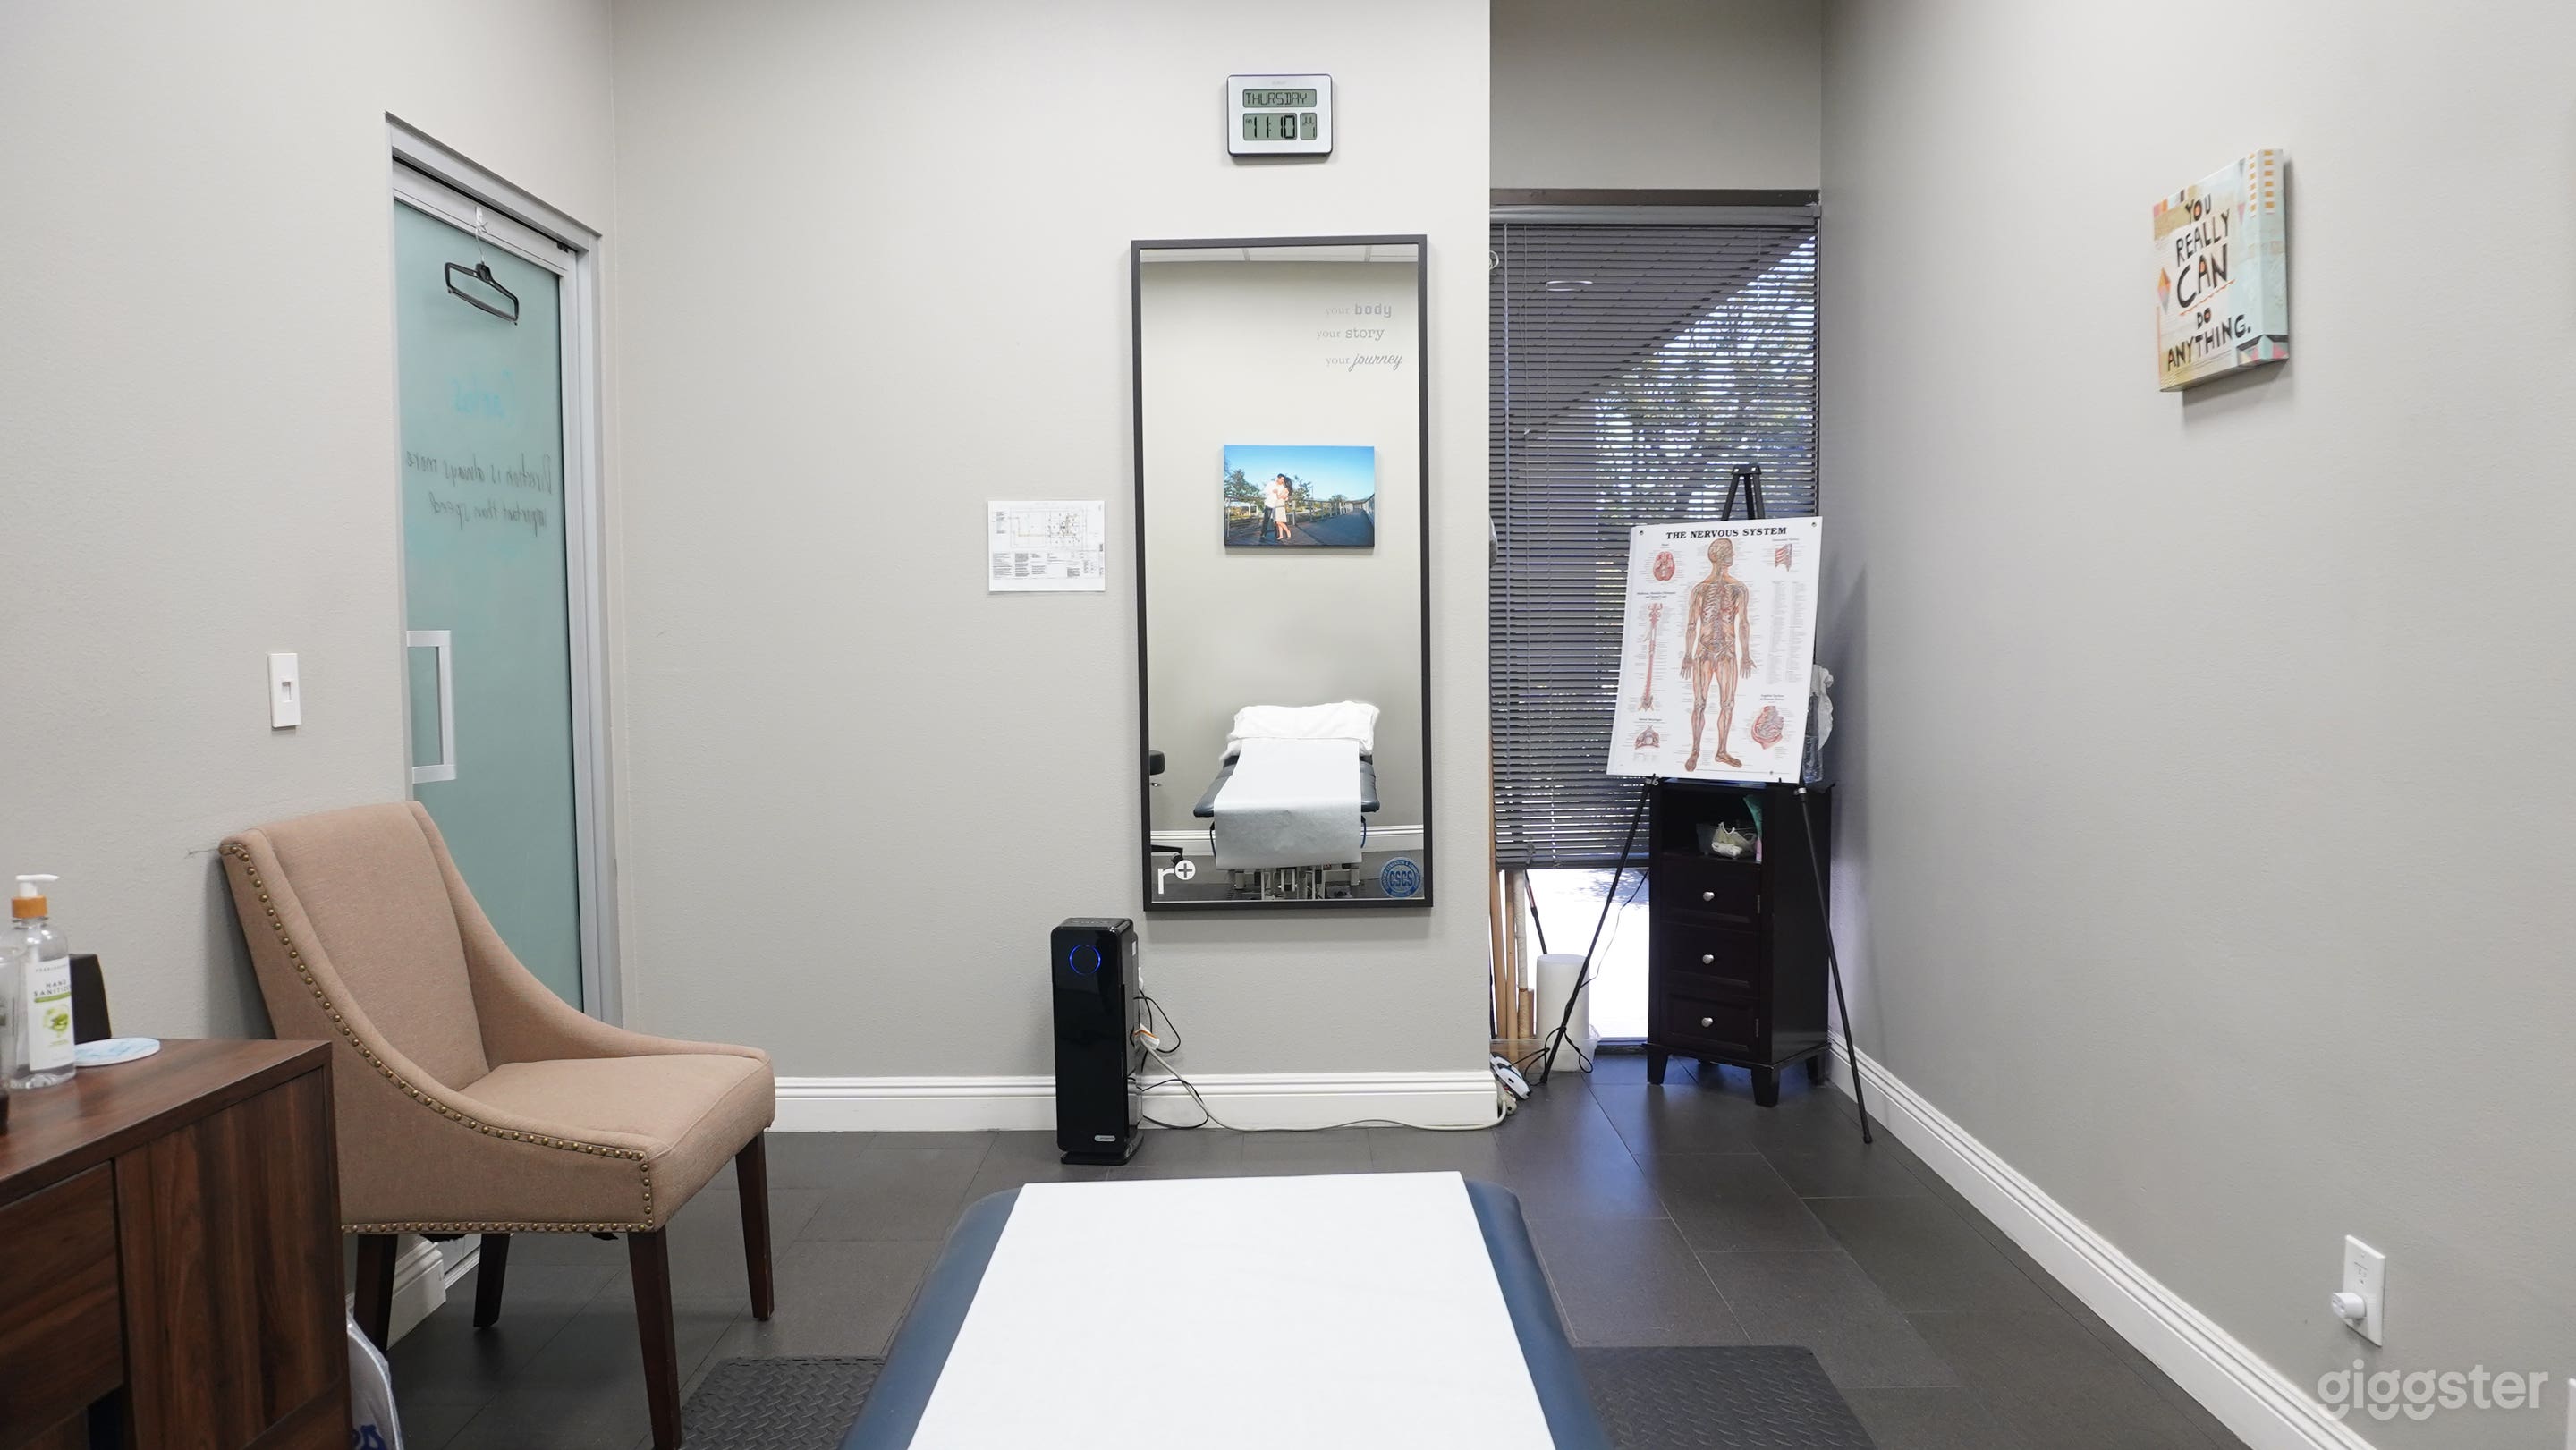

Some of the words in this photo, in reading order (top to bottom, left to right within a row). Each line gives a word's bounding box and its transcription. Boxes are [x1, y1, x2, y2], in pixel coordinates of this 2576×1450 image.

[1245, 92, 1308, 106] THURSDAY
[1253, 114, 1296, 139] 11:10
[2185, 193, 2212, 224] YOU
[2176, 208, 2230, 267] REALLY
[2177, 243, 2227, 308] CAN
[1325, 307, 1351, 318] your
[1354, 303, 1392, 318] body
[2197, 308, 2212, 329] DO
[1317, 330, 1342, 341] your
[1345, 327, 1385, 342] story
[2167, 315, 2251, 371] ANYTHING.
[1326, 357, 1351, 368] your
[1347, 352, 1403, 372] journey
[1666, 531, 1687, 539] THE
[1690, 529, 1739, 538] NERVOUS
[1742, 527, 1787, 537] SYSTEM
